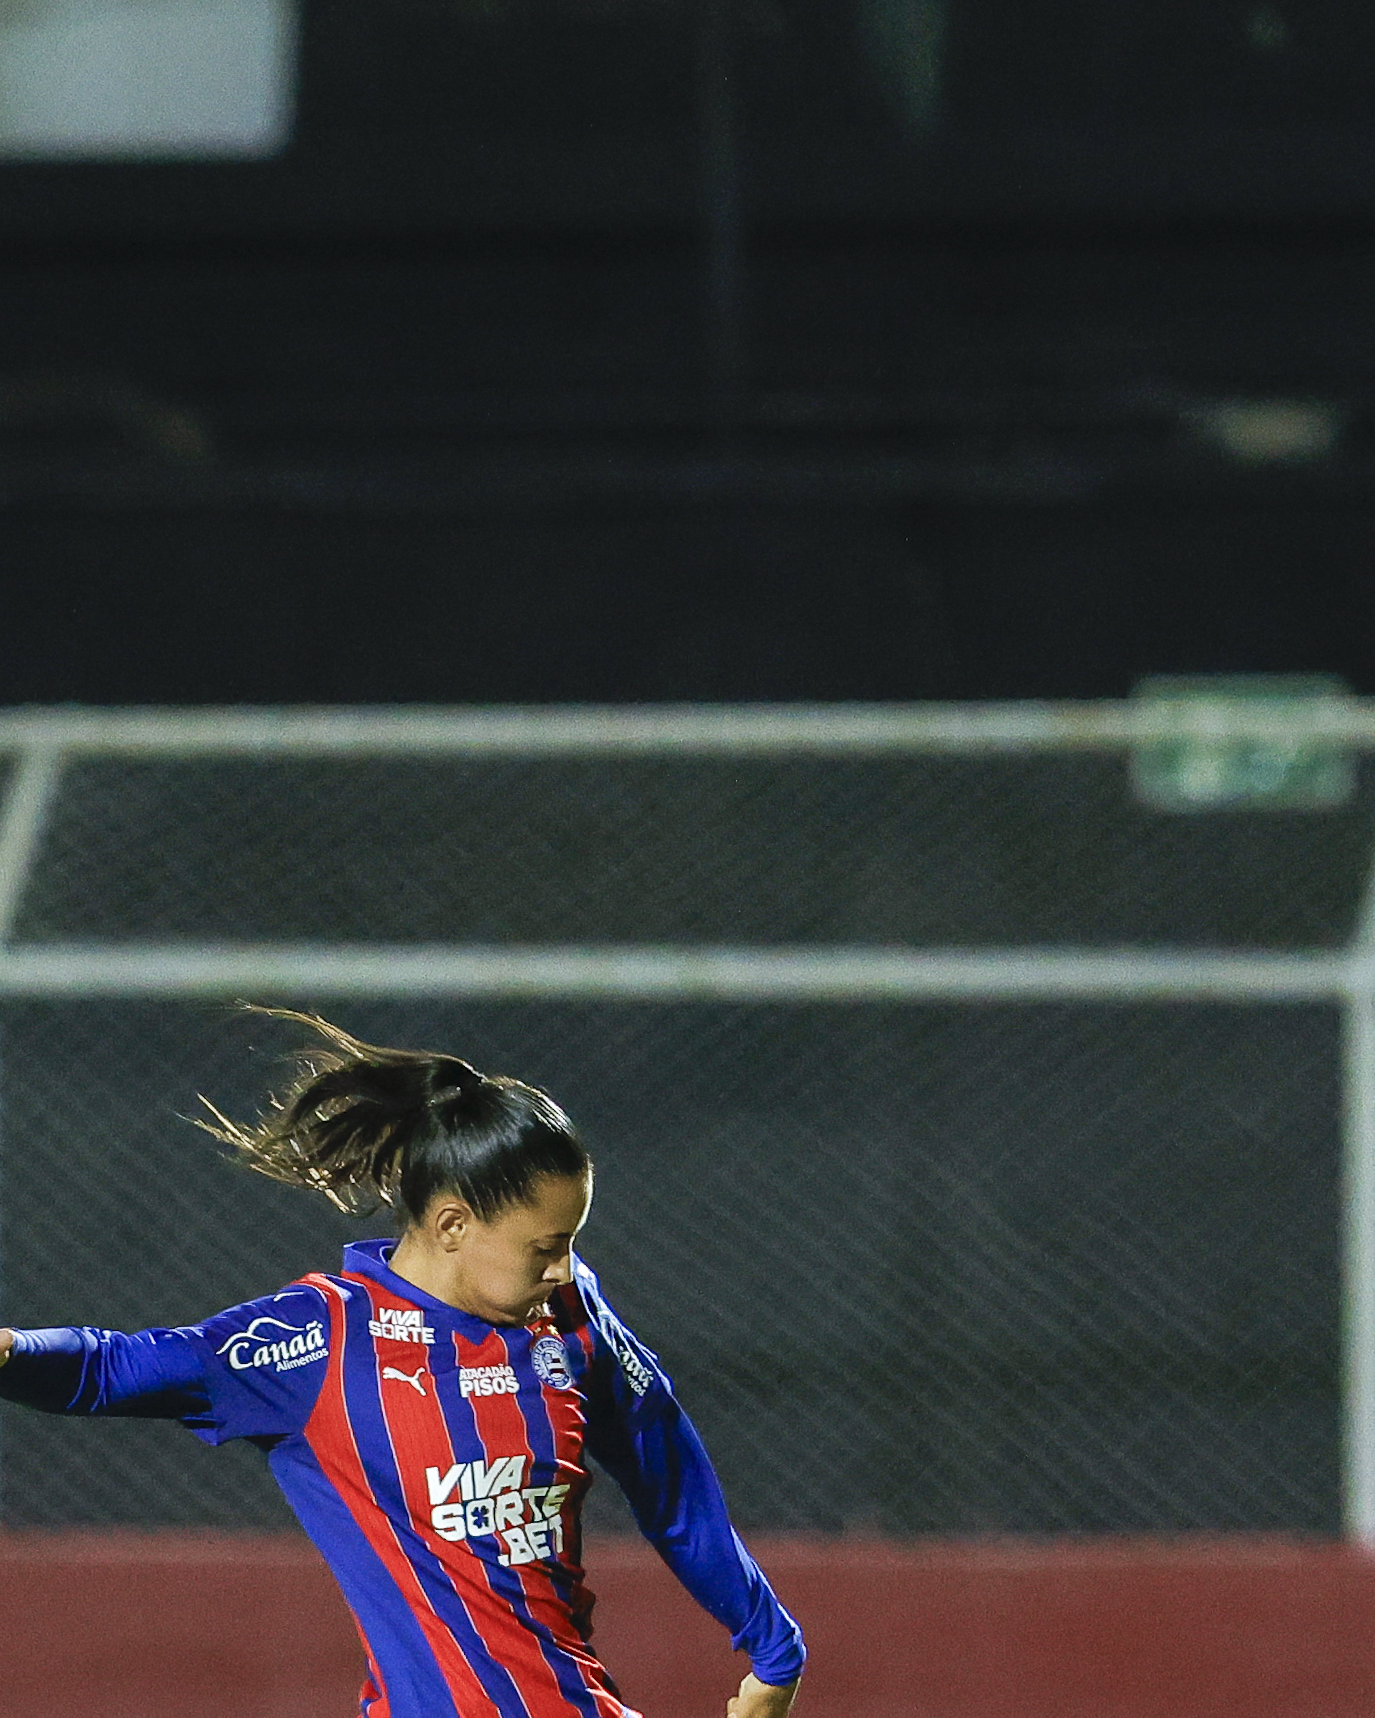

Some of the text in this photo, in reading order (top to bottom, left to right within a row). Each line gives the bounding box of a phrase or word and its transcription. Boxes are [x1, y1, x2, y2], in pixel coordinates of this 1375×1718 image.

[379, 1307, 424, 1327] VIVA
[229, 1320, 325, 1370] Canaã
[368, 1320, 436, 1344] SORTE
[275, 1347, 329, 1373] Alimentos
[459, 1363, 515, 1381] ATACADÃO
[460, 1375, 520, 1398] PISOS
[426, 1455, 527, 1506] VIVA
[431, 1483, 571, 1542] SORTE
[497, 1514, 564, 1567] .BET
